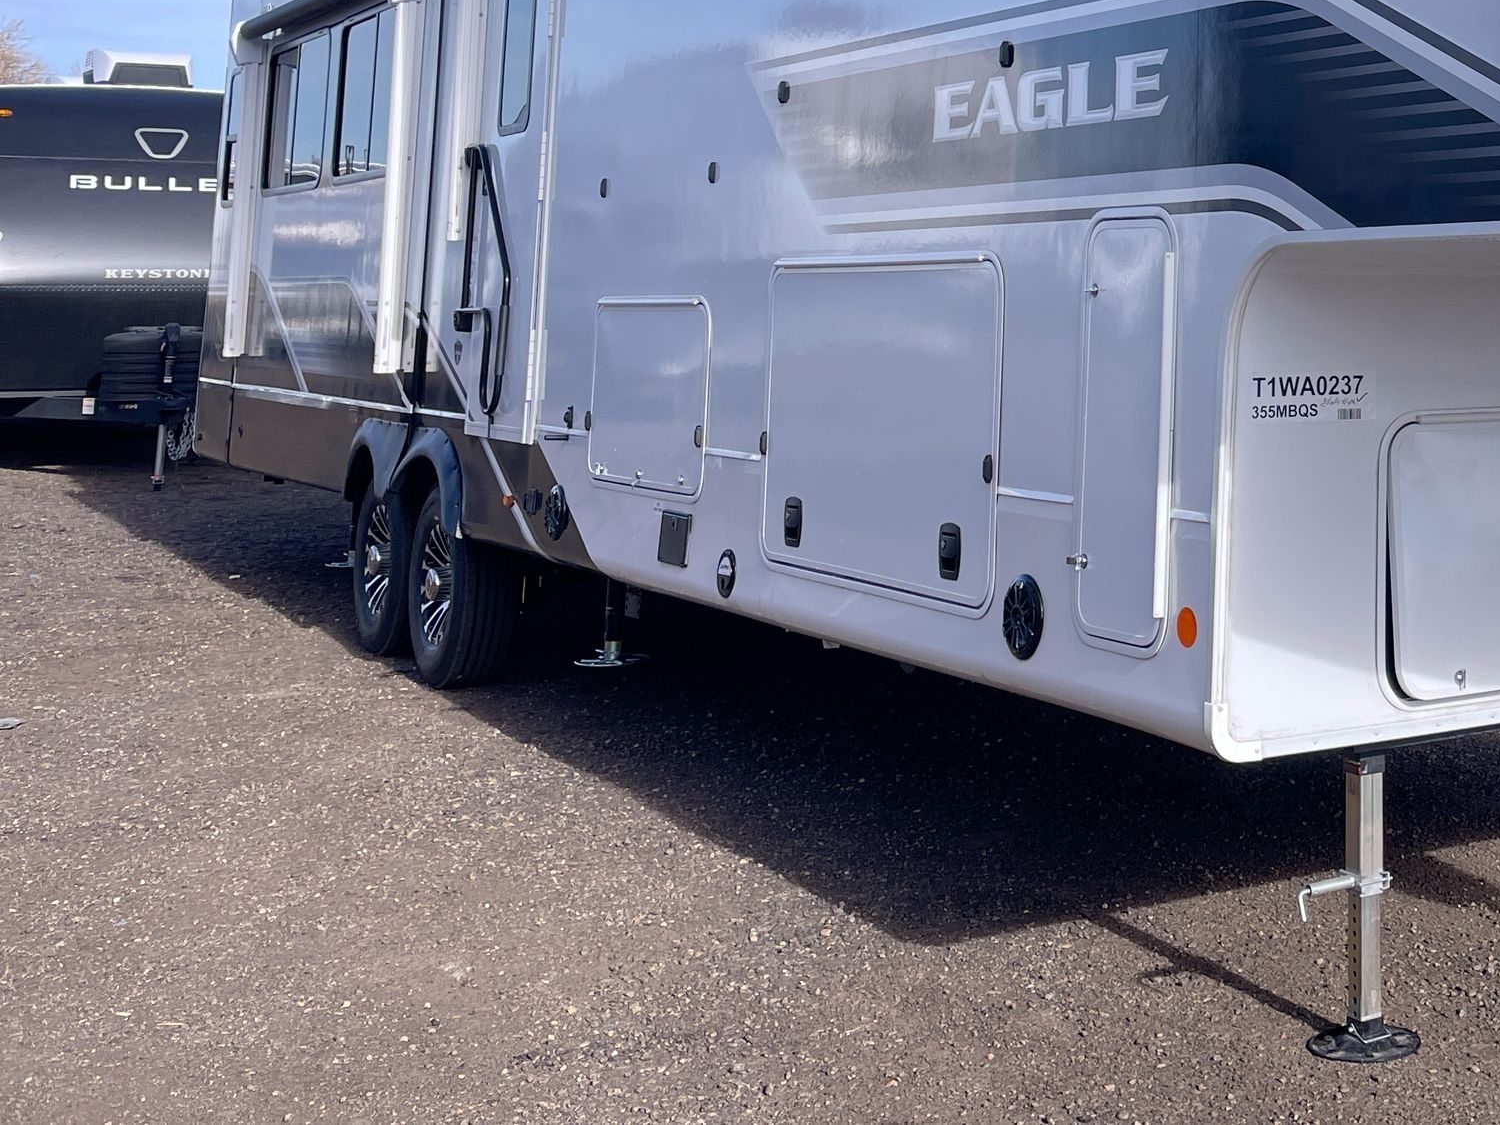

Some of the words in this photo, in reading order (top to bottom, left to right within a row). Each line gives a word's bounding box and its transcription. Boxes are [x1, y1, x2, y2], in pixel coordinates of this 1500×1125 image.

[933, 48, 1169, 143] EAGLE
[1252, 375, 1364, 397] T1WA0237
[1251, 403, 1318, 419] 355MBQS
